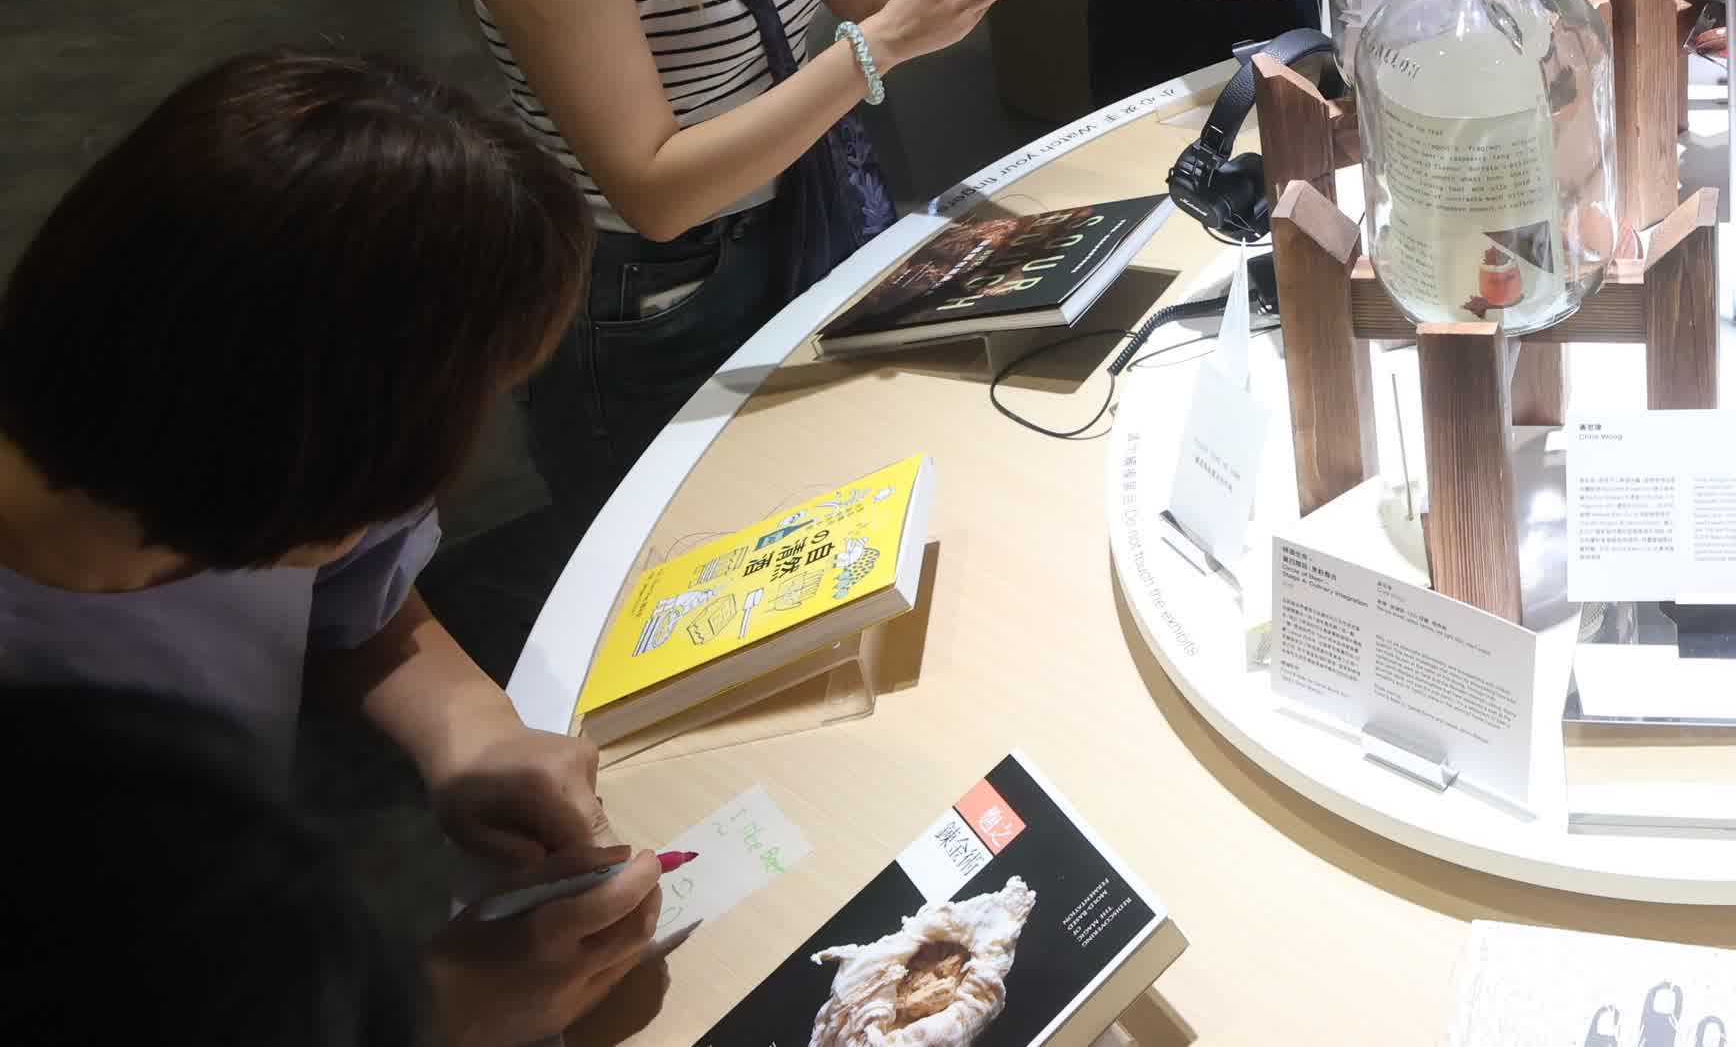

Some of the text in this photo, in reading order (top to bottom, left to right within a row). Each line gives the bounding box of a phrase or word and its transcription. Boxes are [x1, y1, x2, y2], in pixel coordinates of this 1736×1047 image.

[1039, 122, 1098, 156] Watch
[999, 150, 1040, 177] your
[1009, 214, 1106, 297] SOUR
[742, 529, 830, 578] の清酒
[769, 541, 835, 582] 自然
[1062, 877, 1110, 926] FERMENTATION
[1067, 889, 1108, 931] MOLD-BASED
[1081, 896, 1133, 948] REDISCOVERING
[1072, 925, 1083, 938] OF
[1075, 905, 1114, 943] THE MAGIC
